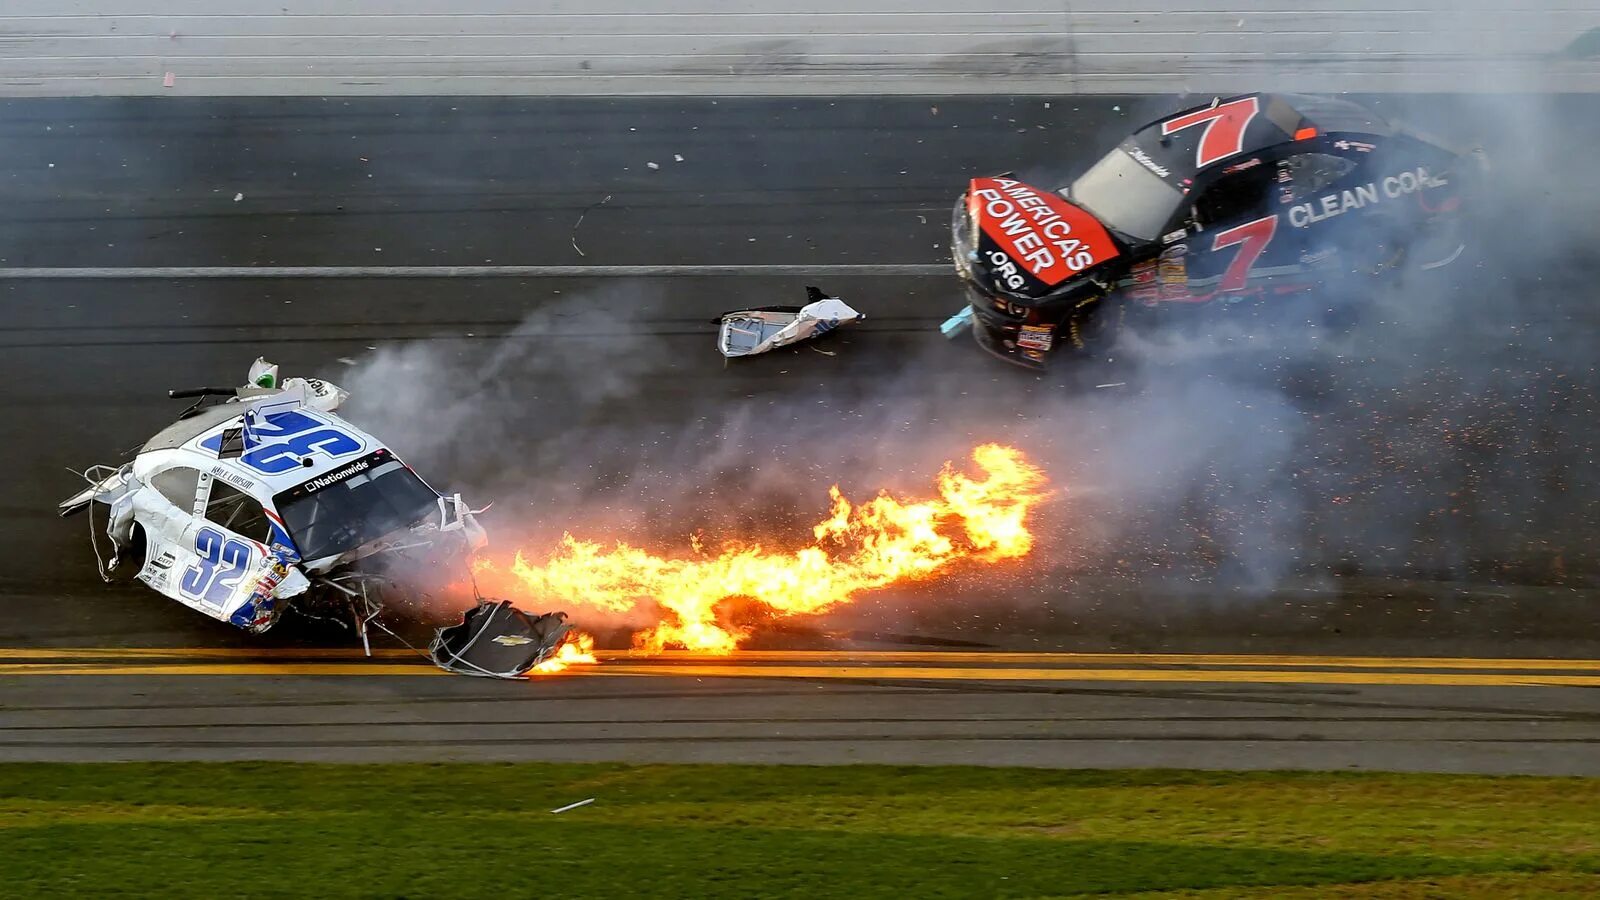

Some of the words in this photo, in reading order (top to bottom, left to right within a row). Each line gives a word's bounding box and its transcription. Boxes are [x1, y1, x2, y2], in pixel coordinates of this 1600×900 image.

[1161, 97, 1259, 169] 7
[975, 188, 1055, 275] POWER
[994, 176, 1095, 272] AMERICA'S
[1289, 183, 1378, 229] CLEAN
[1211, 214, 1279, 293] 7
[227, 473, 255, 490] LARSON
[314, 460, 369, 489] Nationwide
[179, 527, 254, 610] 32
